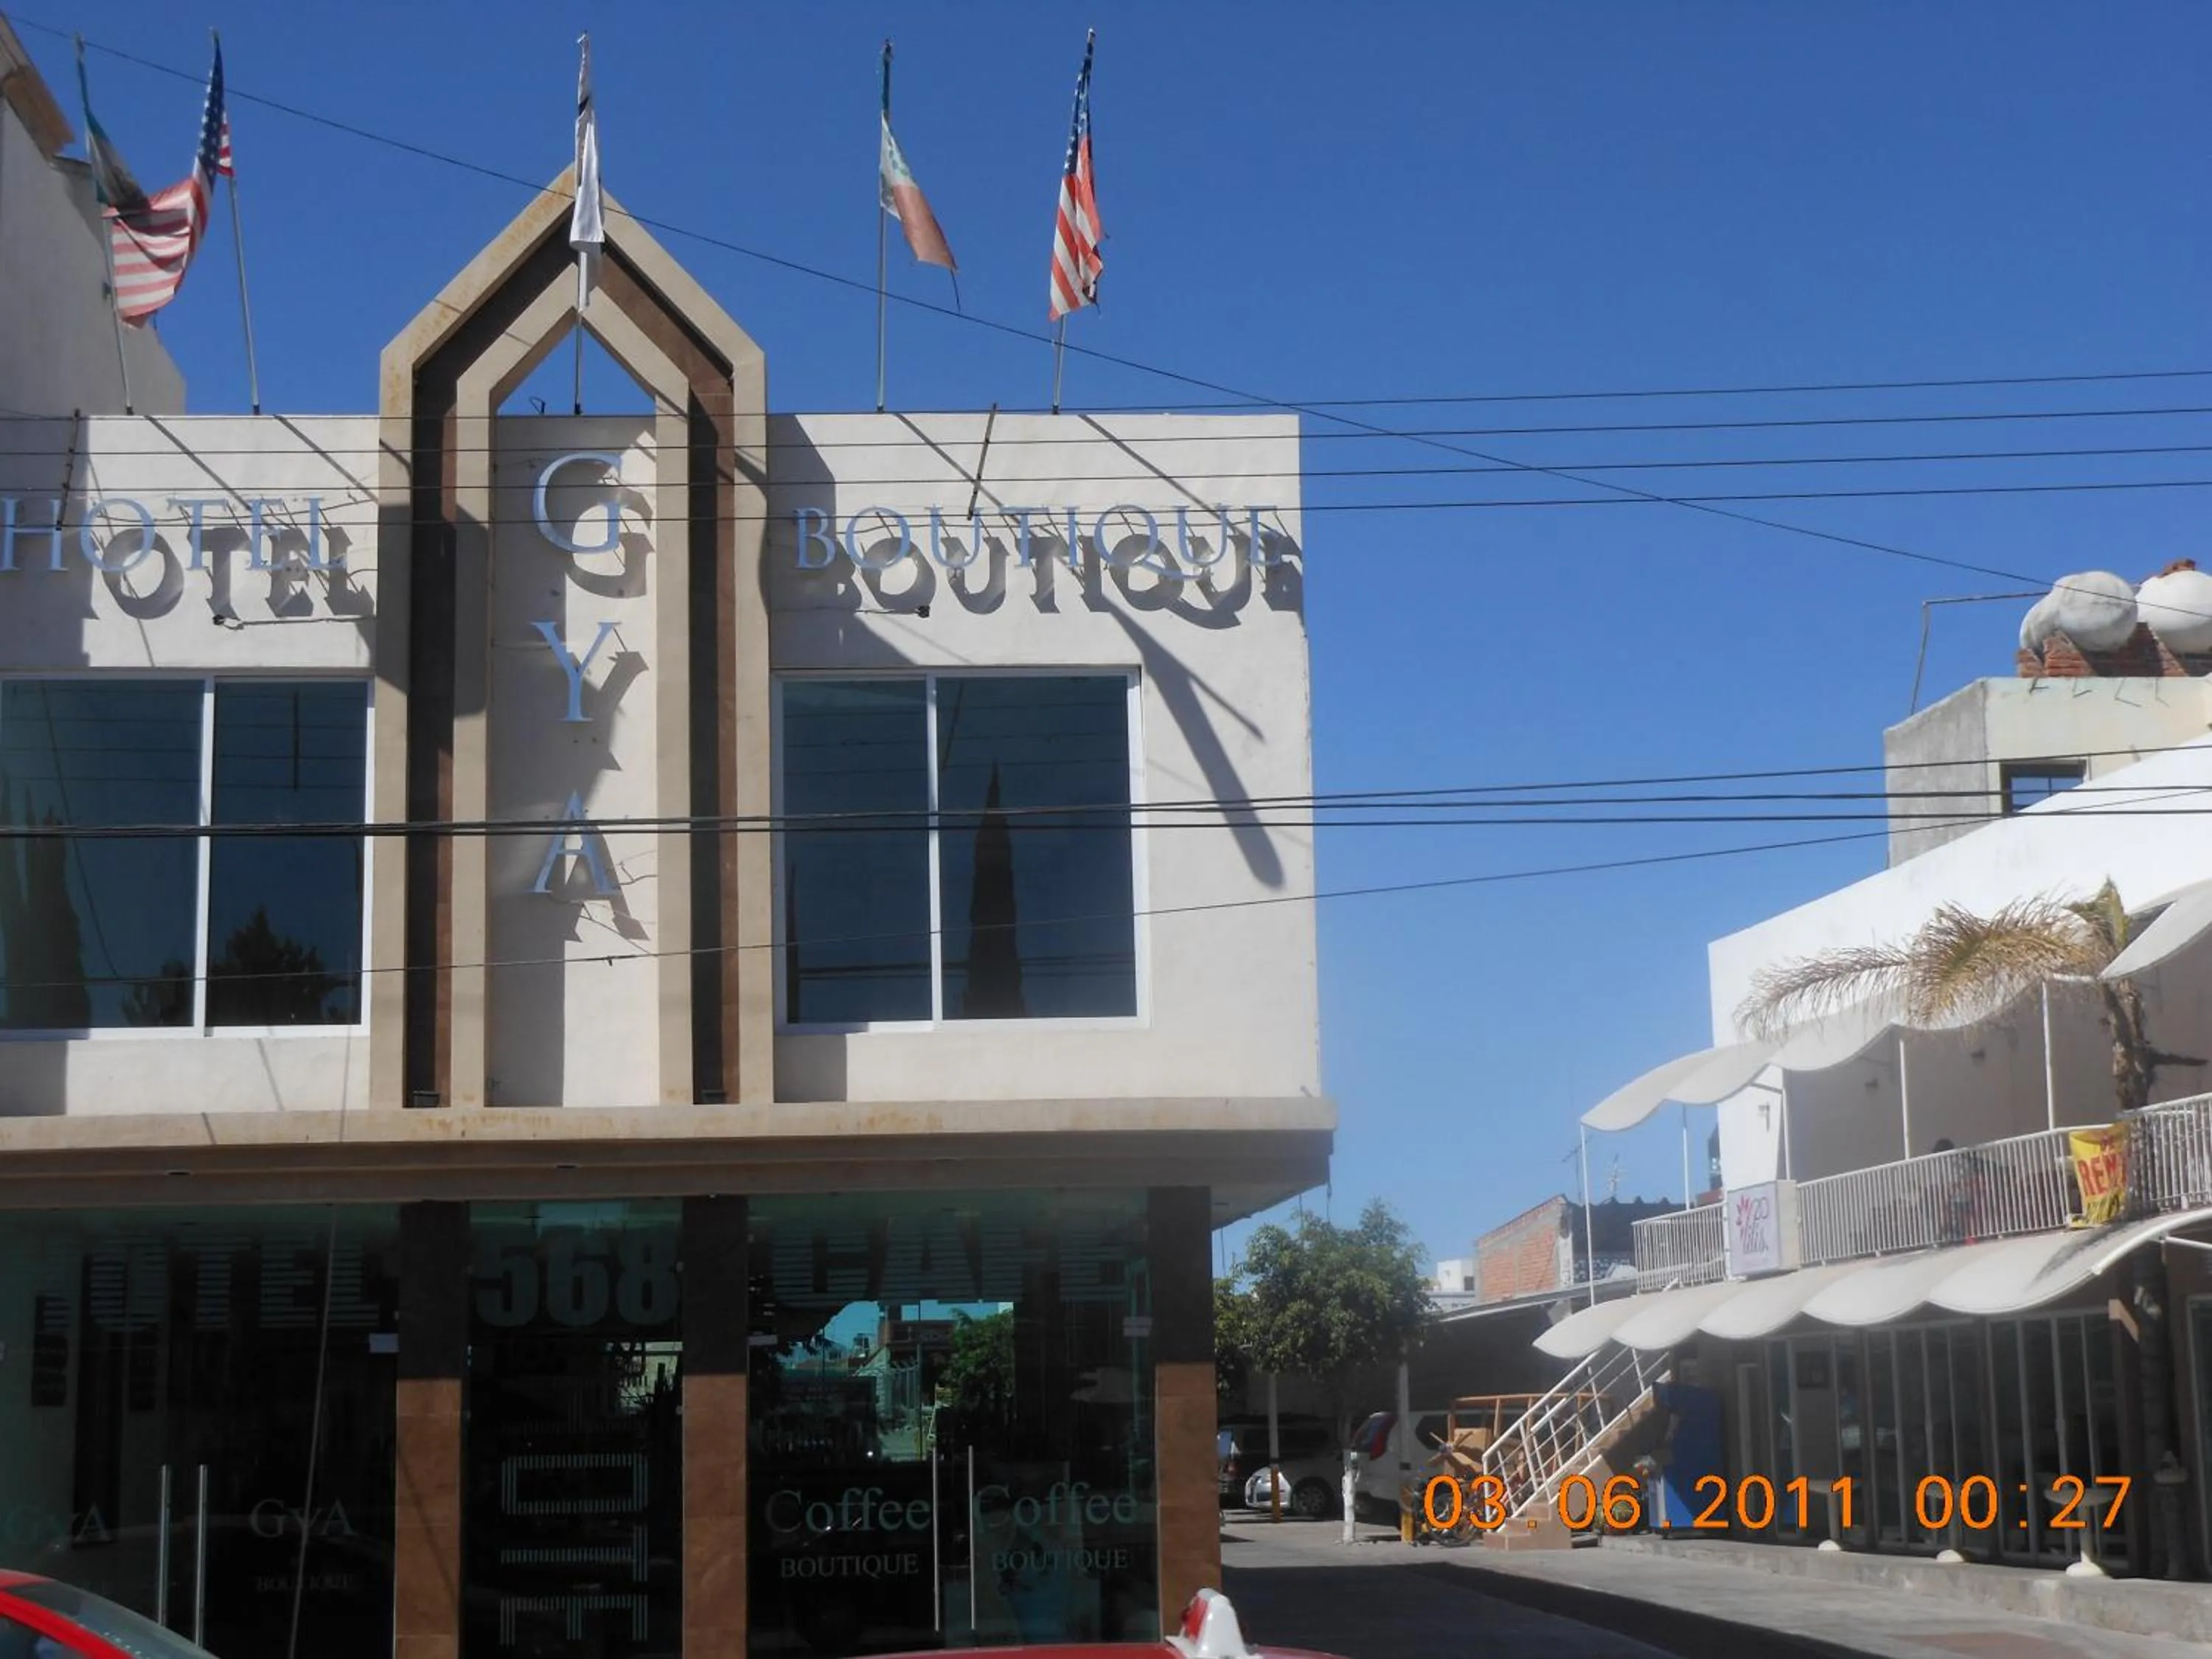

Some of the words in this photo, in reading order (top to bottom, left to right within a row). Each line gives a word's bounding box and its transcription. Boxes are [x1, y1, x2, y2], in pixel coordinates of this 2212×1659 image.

[0, 495, 347, 573] HOTEL
[792, 503, 1286, 580] BOUTIQUE
[470, 1224, 681, 1328] 568
[764, 1486, 931, 1534] Coffee
[974, 1481, 1139, 1530] Coffee
[779, 1553, 919, 1580] BOUTIQUE
[991, 1547, 1129, 1573] BOUTIQUE
